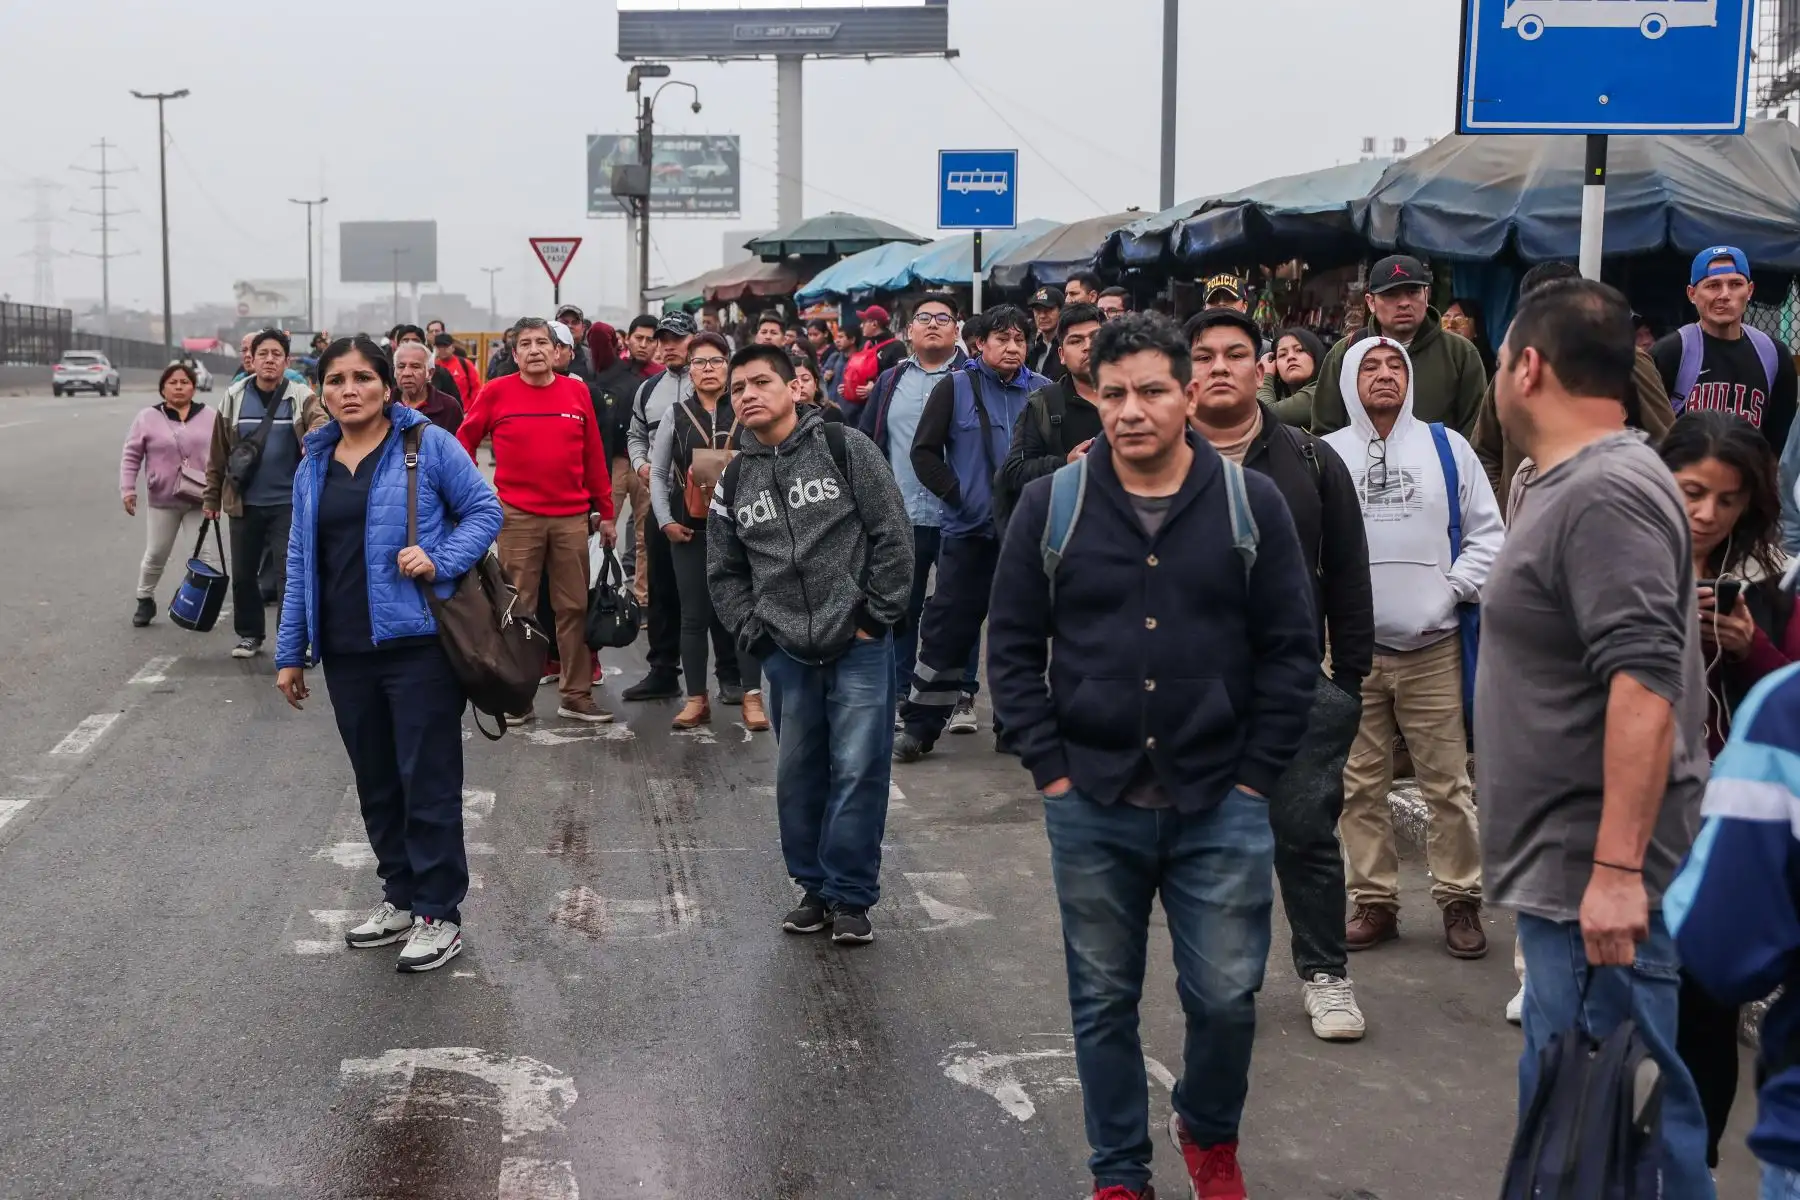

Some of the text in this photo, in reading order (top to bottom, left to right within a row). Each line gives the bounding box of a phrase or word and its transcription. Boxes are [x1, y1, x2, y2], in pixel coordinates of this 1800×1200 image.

[542, 245, 568, 253] CEDA EL
[1206, 274, 1238, 292] POLICIA
